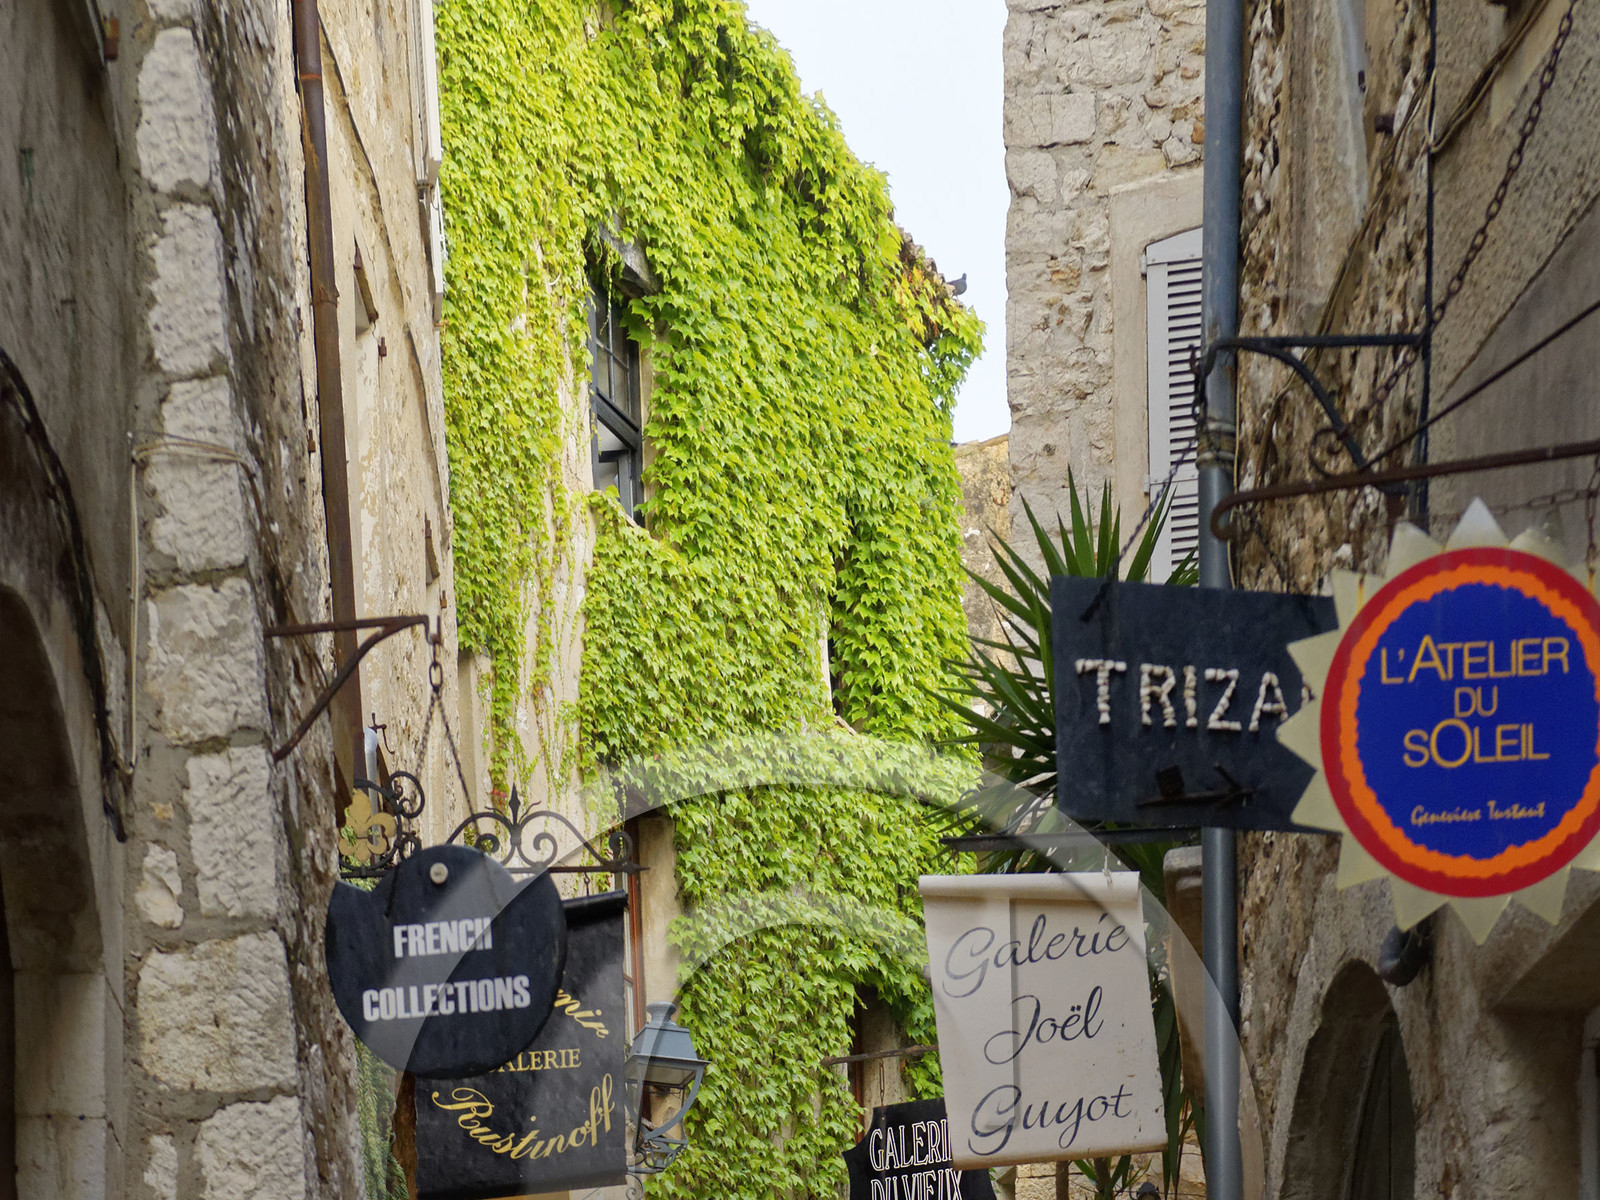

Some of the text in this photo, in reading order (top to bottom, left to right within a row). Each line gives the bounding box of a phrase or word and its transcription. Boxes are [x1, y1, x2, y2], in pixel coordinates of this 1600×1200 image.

[1381, 634, 1570, 684] L'ATELIER
[1075, 657, 1309, 732] TRIZA
[1454, 685, 1498, 718] DU
[1403, 718, 1550, 768] SOLEIL
[393, 916, 493, 958] FRENCH
[942, 913, 1130, 998] Galerie
[362, 974, 531, 1022] COLLECTIONS
[984, 985, 1104, 1065] Joël
[432, 1073, 615, 1160] Rustinoff
[968, 1084, 1133, 1156] Guyot
[869, 1119, 952, 1172] GALERI
